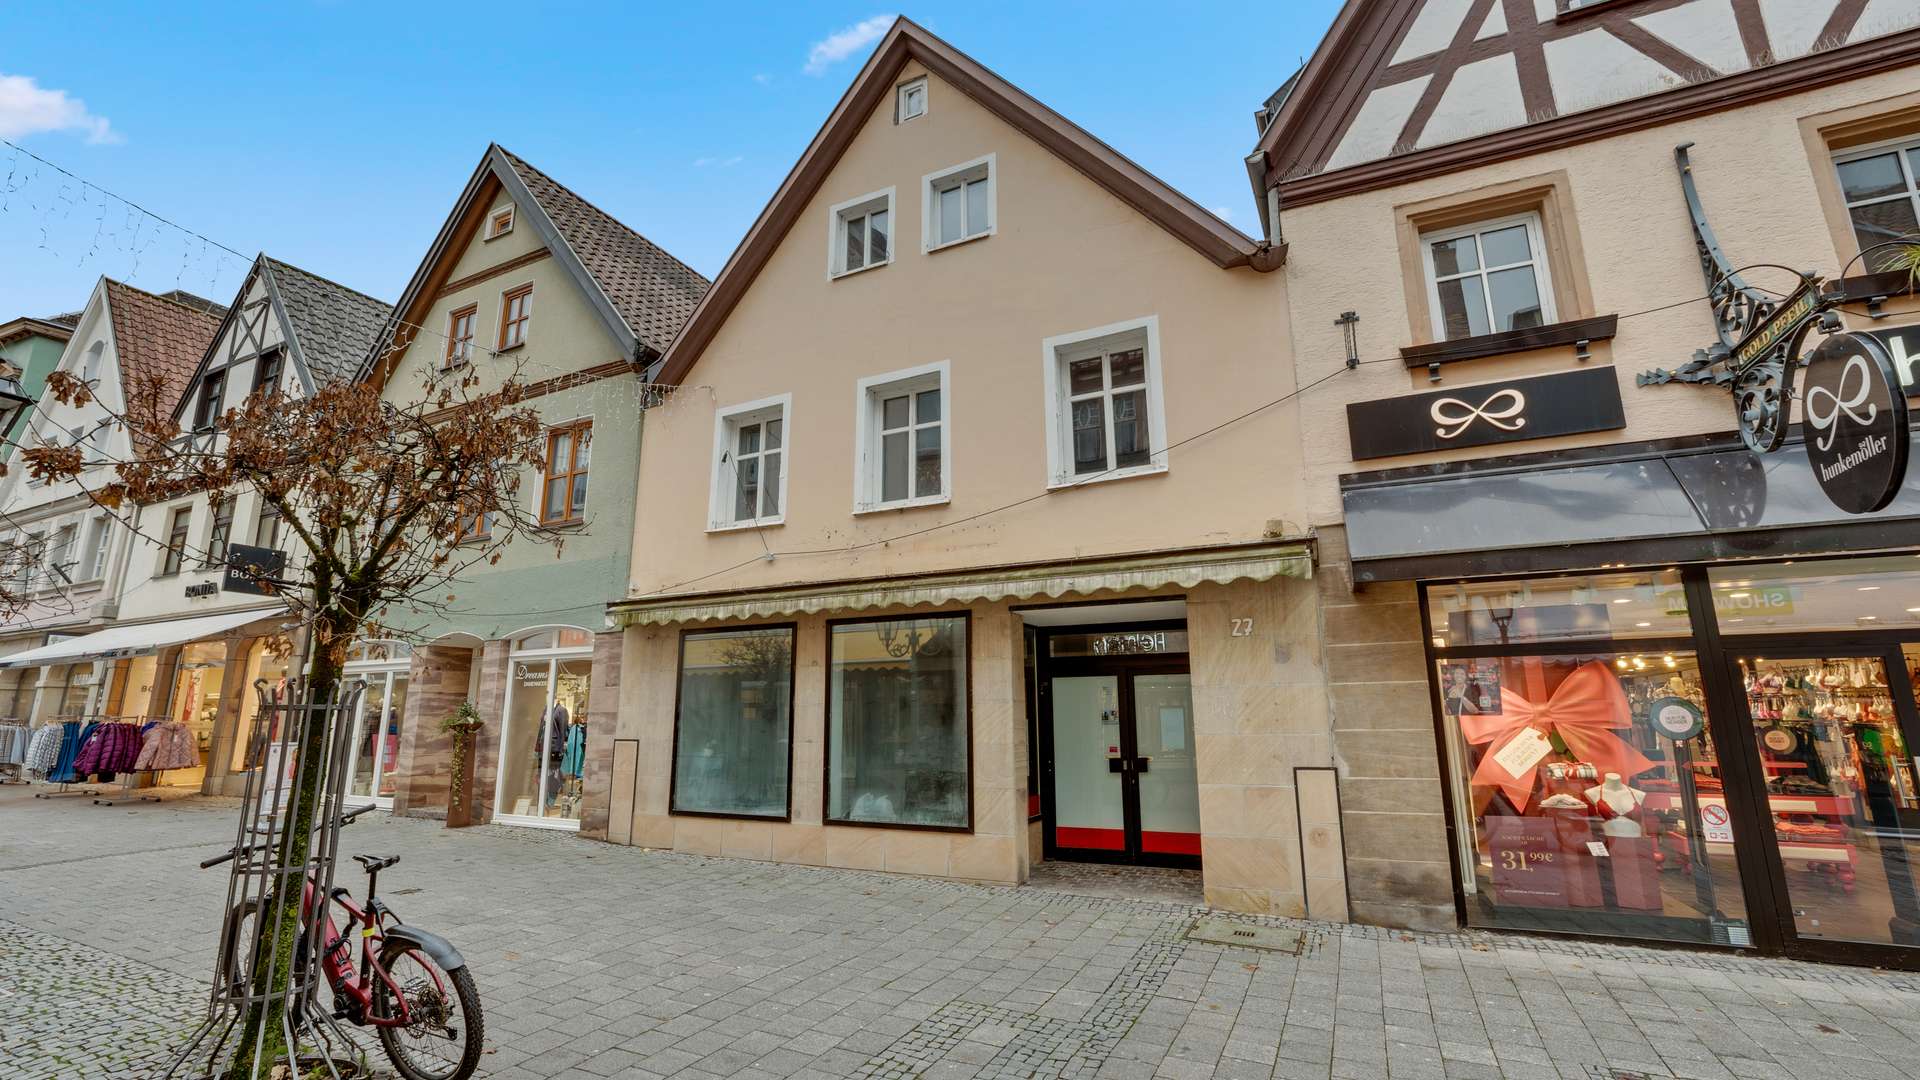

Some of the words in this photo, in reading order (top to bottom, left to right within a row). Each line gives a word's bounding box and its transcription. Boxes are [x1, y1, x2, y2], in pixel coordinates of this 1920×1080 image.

[1741, 330, 1771, 361] GOLD
[1772, 299, 1809, 336] PFEIL
[1820, 434, 1888, 483] hunkemöller
[1231, 618, 1253, 637] 27
